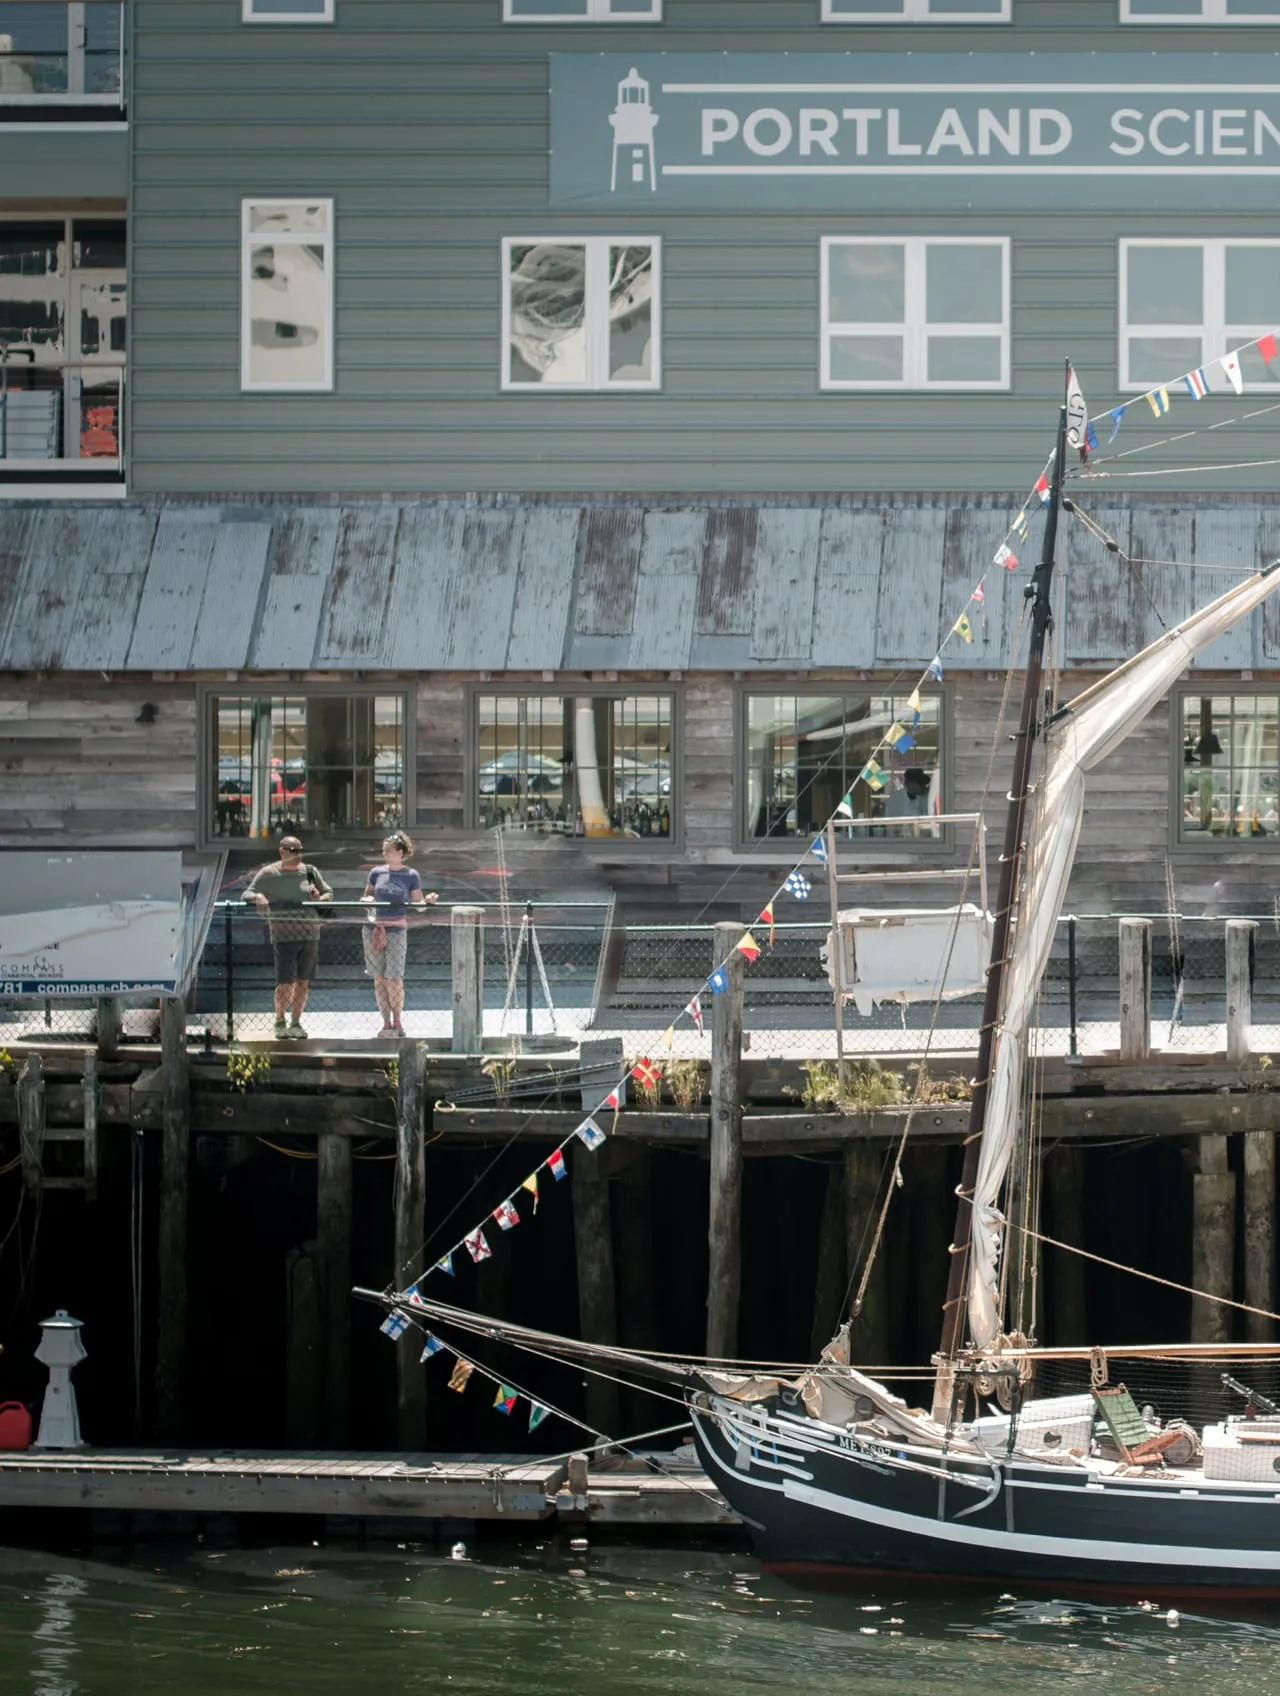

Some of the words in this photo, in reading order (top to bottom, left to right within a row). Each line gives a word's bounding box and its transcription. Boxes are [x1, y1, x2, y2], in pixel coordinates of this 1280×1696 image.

[701, 108, 1073, 156] PORTLAND
[0, 963, 65, 973] COMPASS
[0, 982, 23, 994] 81
[37, 980, 165, 994] compass-cb
